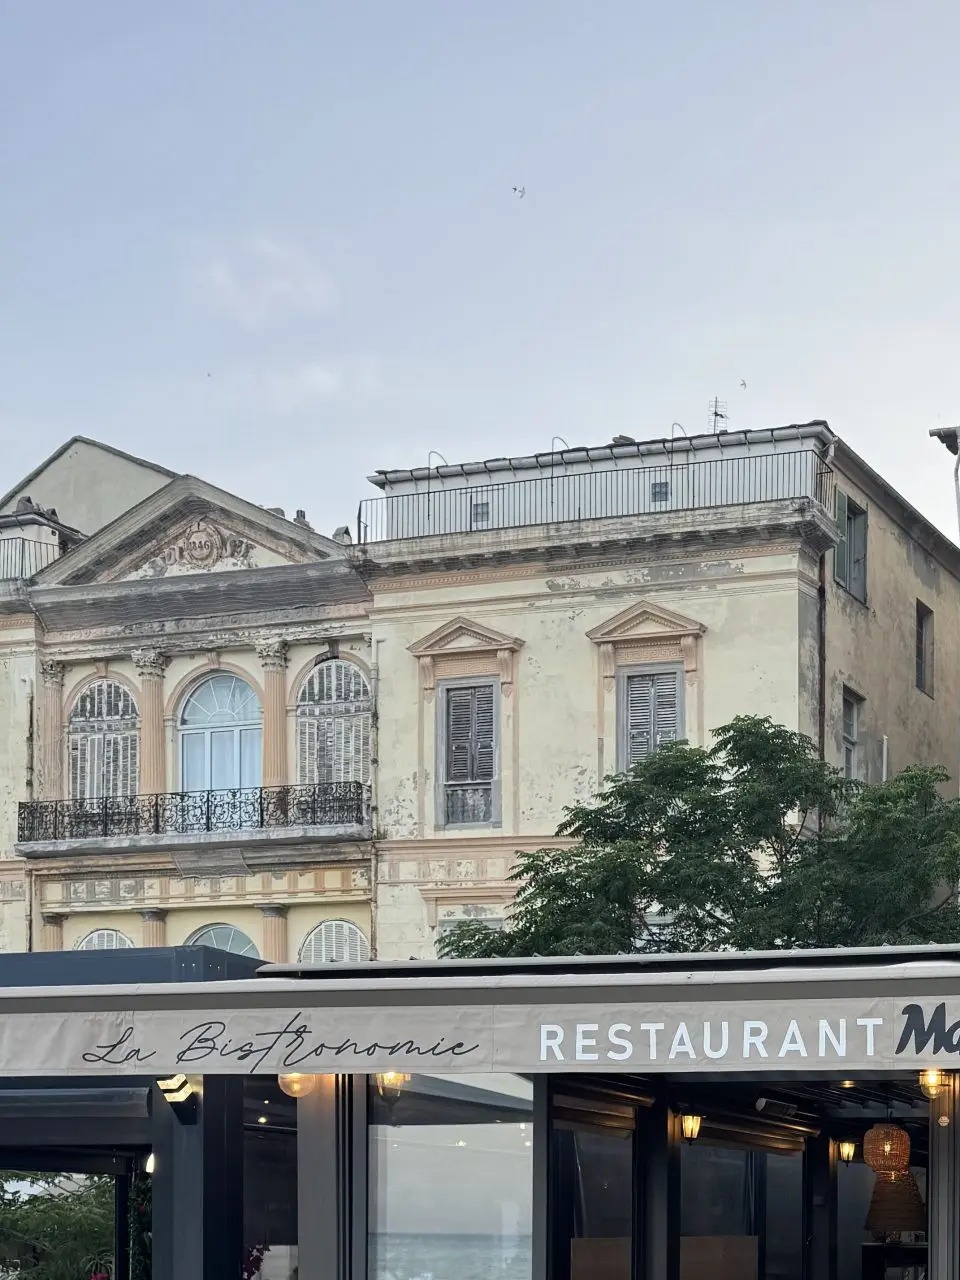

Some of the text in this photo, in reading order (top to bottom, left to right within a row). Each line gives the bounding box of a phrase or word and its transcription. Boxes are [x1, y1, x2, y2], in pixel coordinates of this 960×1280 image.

[82, 1011, 480, 1074] La Bistronomie
[539, 1017, 883, 1061] RESTAURANT
